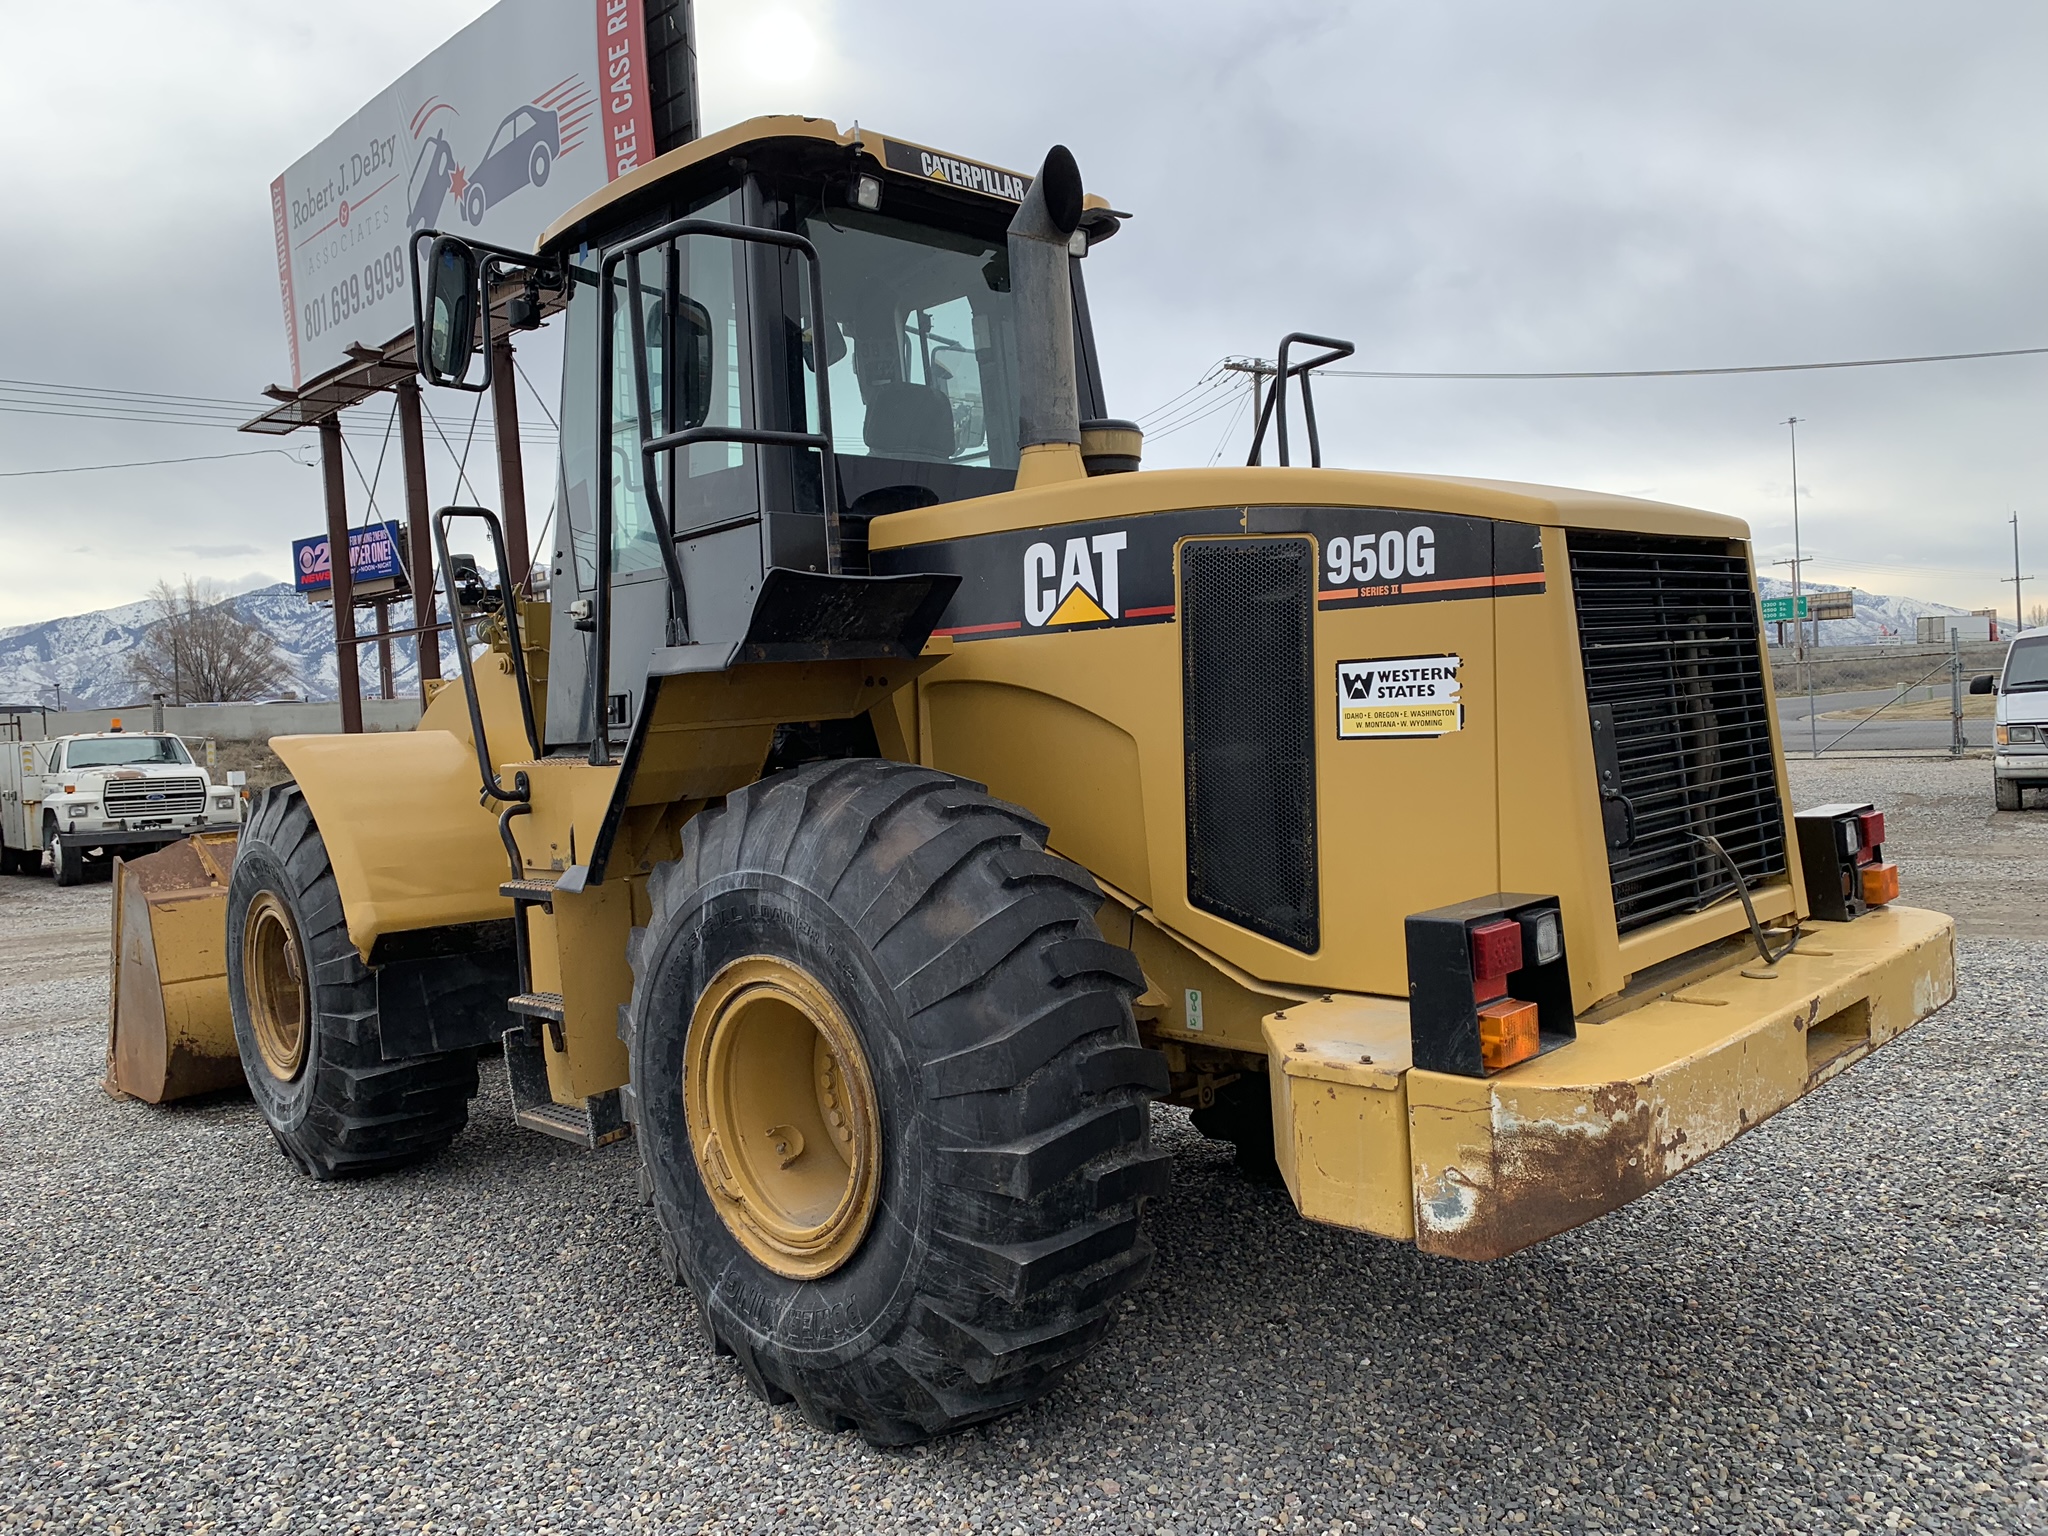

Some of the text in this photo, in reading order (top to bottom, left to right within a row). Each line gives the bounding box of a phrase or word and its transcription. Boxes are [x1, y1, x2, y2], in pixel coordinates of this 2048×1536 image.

[608, 38, 633, 115] CASE
[613, 118, 639, 177] REE
[292, 134, 396, 229] Robert J. DeBry
[921, 151, 1024, 201] CATERPILLAR
[272, 186, 287, 273] INJURED?
[309, 205, 389, 276] ASSOCIATES
[304, 245, 405, 342] 801.699.9999
[314, 543, 330, 572] 2
[371, 540, 392, 563] ONE!
[1326, 526, 1435, 584] 950G
[301, 572, 331, 584] NEWS
[1024, 531, 1127, 627] CAT
[1360, 584, 1399, 597] SERIES II
[1377, 667, 1456, 683] WESTERN
[1377, 684, 1435, 699] STATES
[1344, 711, 1364, 720] IDAHO
[1374, 710, 1400, 718] OREGON
[1410, 709, 1455, 717] WASHINGTON
[1365, 720, 1397, 728] MONTANA
[749, 904, 821, 945] LOADER
